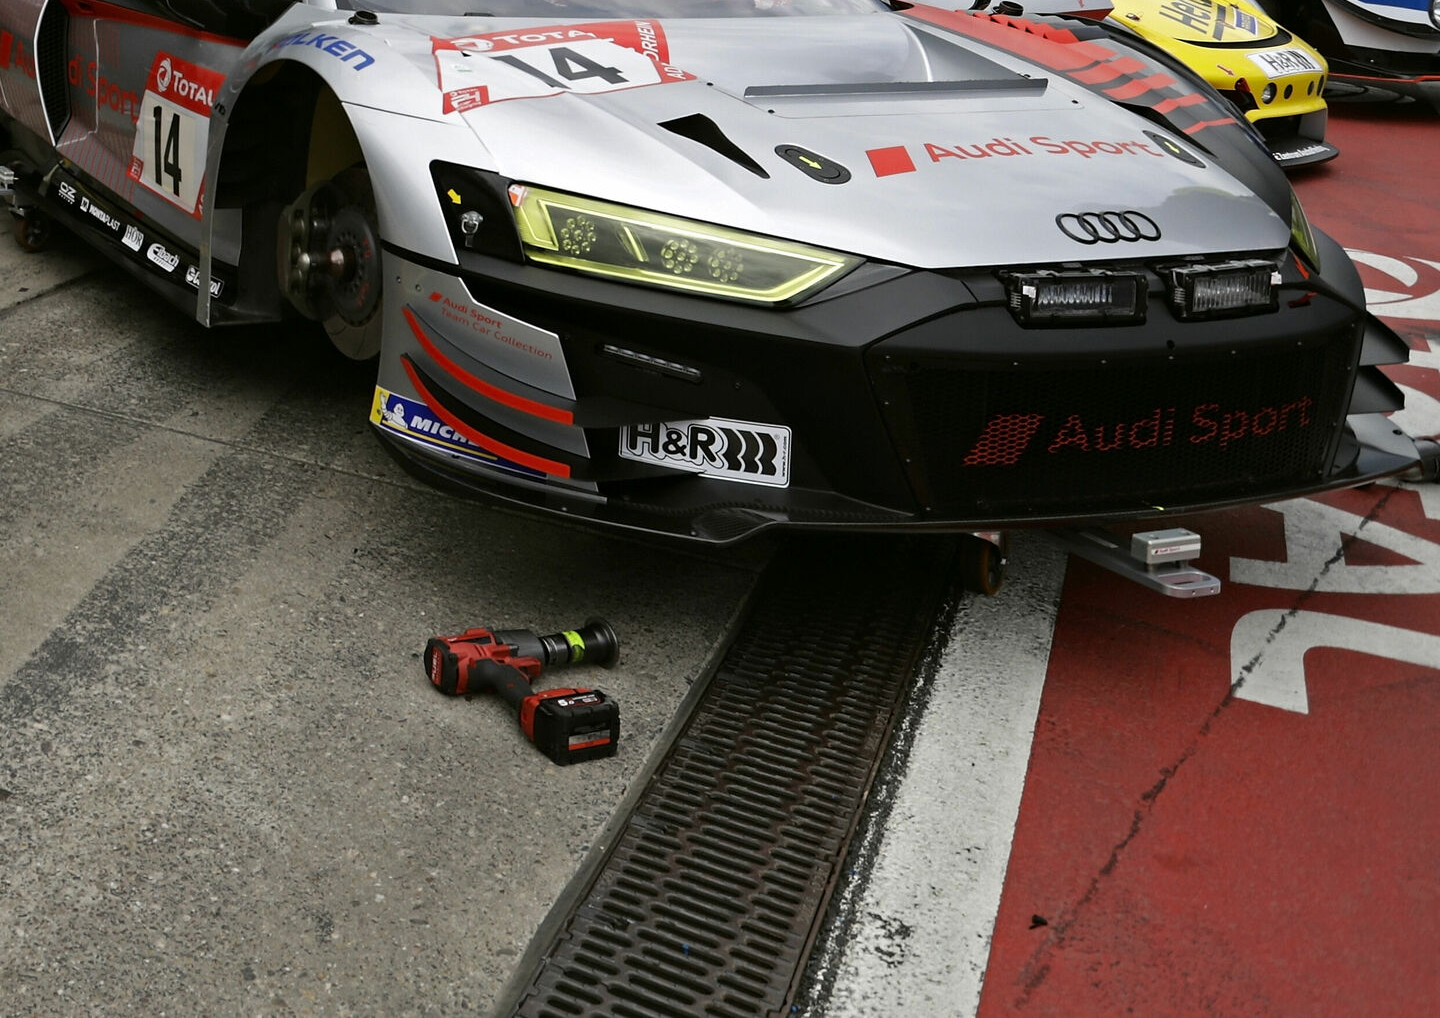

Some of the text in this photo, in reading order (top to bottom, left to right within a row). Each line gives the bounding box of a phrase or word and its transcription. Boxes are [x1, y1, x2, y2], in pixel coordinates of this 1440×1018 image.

[490, 46, 630, 90] 14
[172, 70, 214, 107] TOTAL
[152, 105, 182, 196] 14
[923, 135, 1164, 164] Audi Sport
[89, 202, 121, 232] MONTAPLAST
[441, 307, 553, 360] Team Car Collection
[443, 298, 503, 329] Audi Sport
[630, 423, 718, 463] H&R
[1048, 395, 1312, 454] Audi Sport
